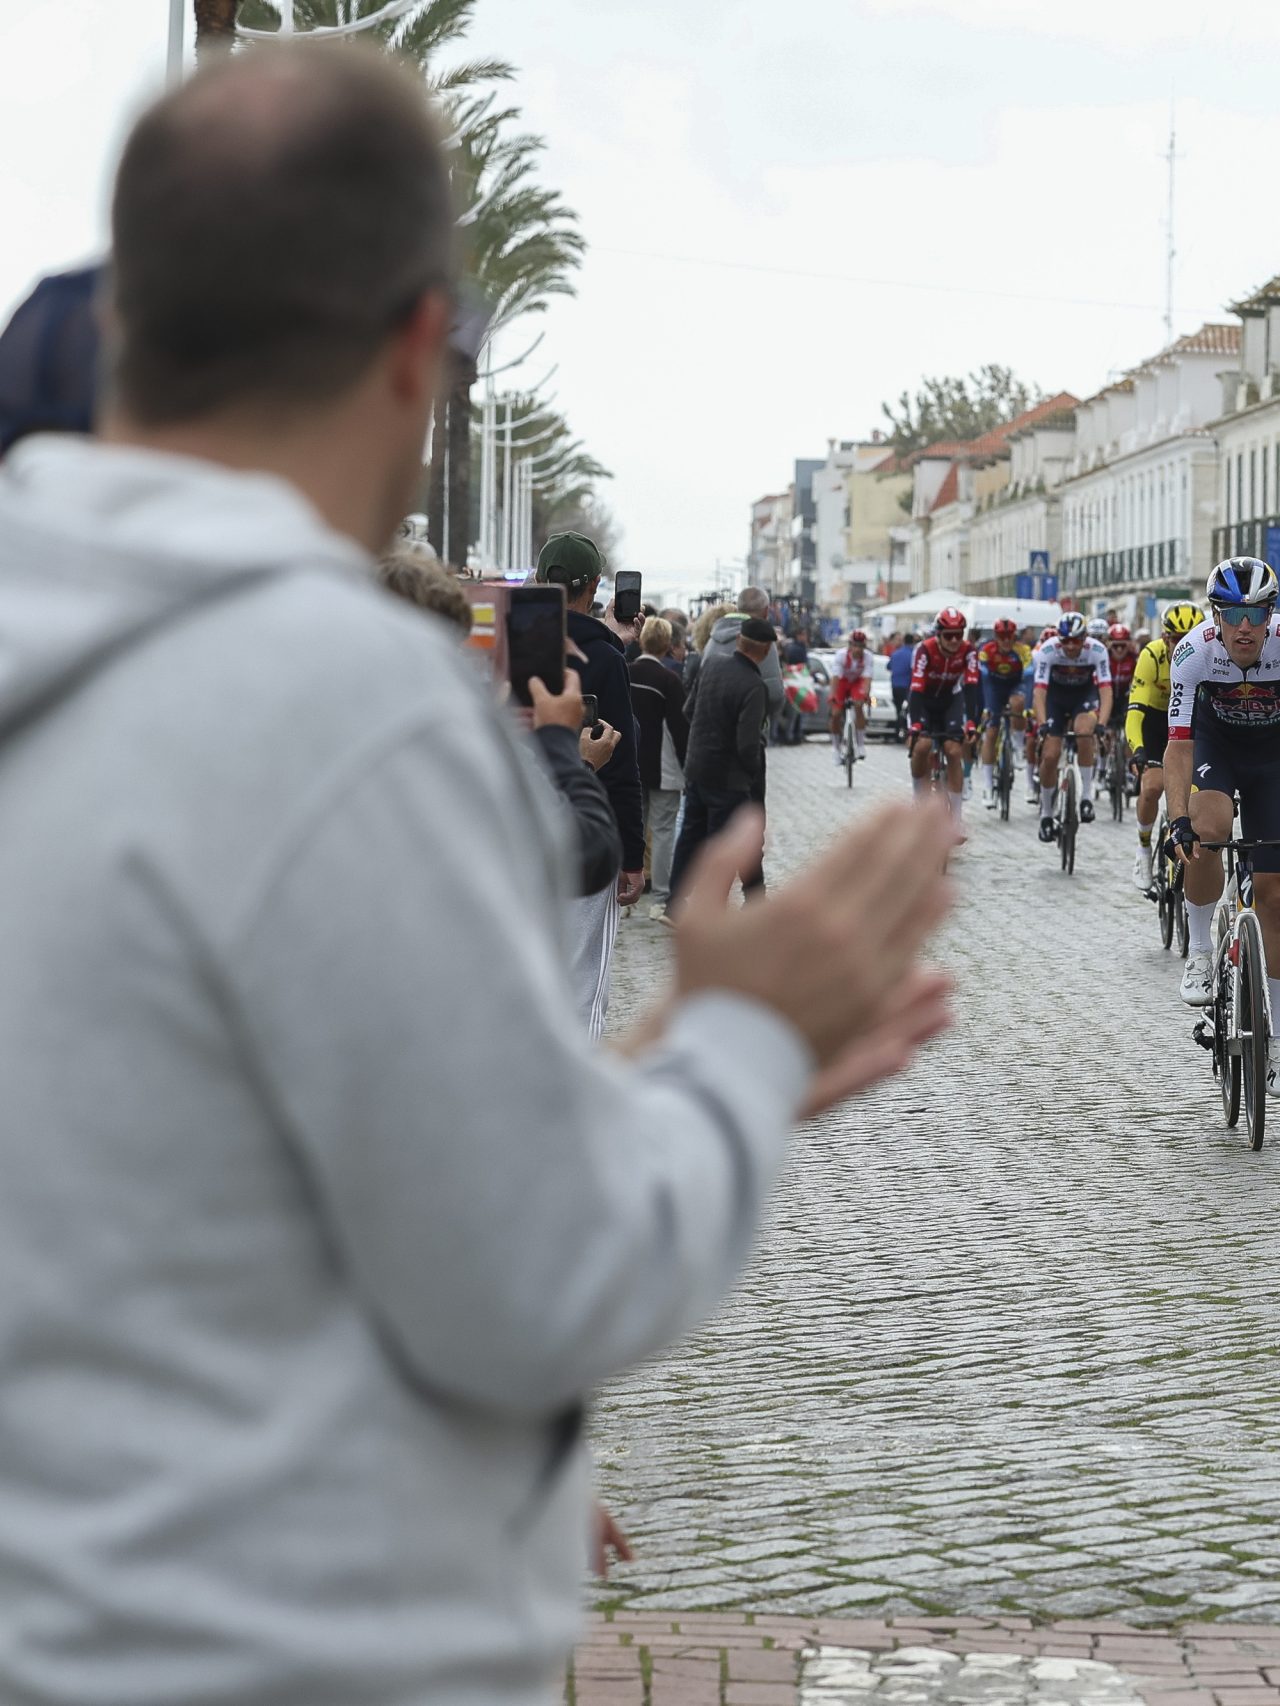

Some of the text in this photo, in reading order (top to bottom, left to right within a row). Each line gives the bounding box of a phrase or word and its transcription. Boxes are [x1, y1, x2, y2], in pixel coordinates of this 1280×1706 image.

[1173, 641, 1192, 662] BORA
[1213, 657, 1230, 668] BOSS
[1170, 682, 1184, 717] BOSS
